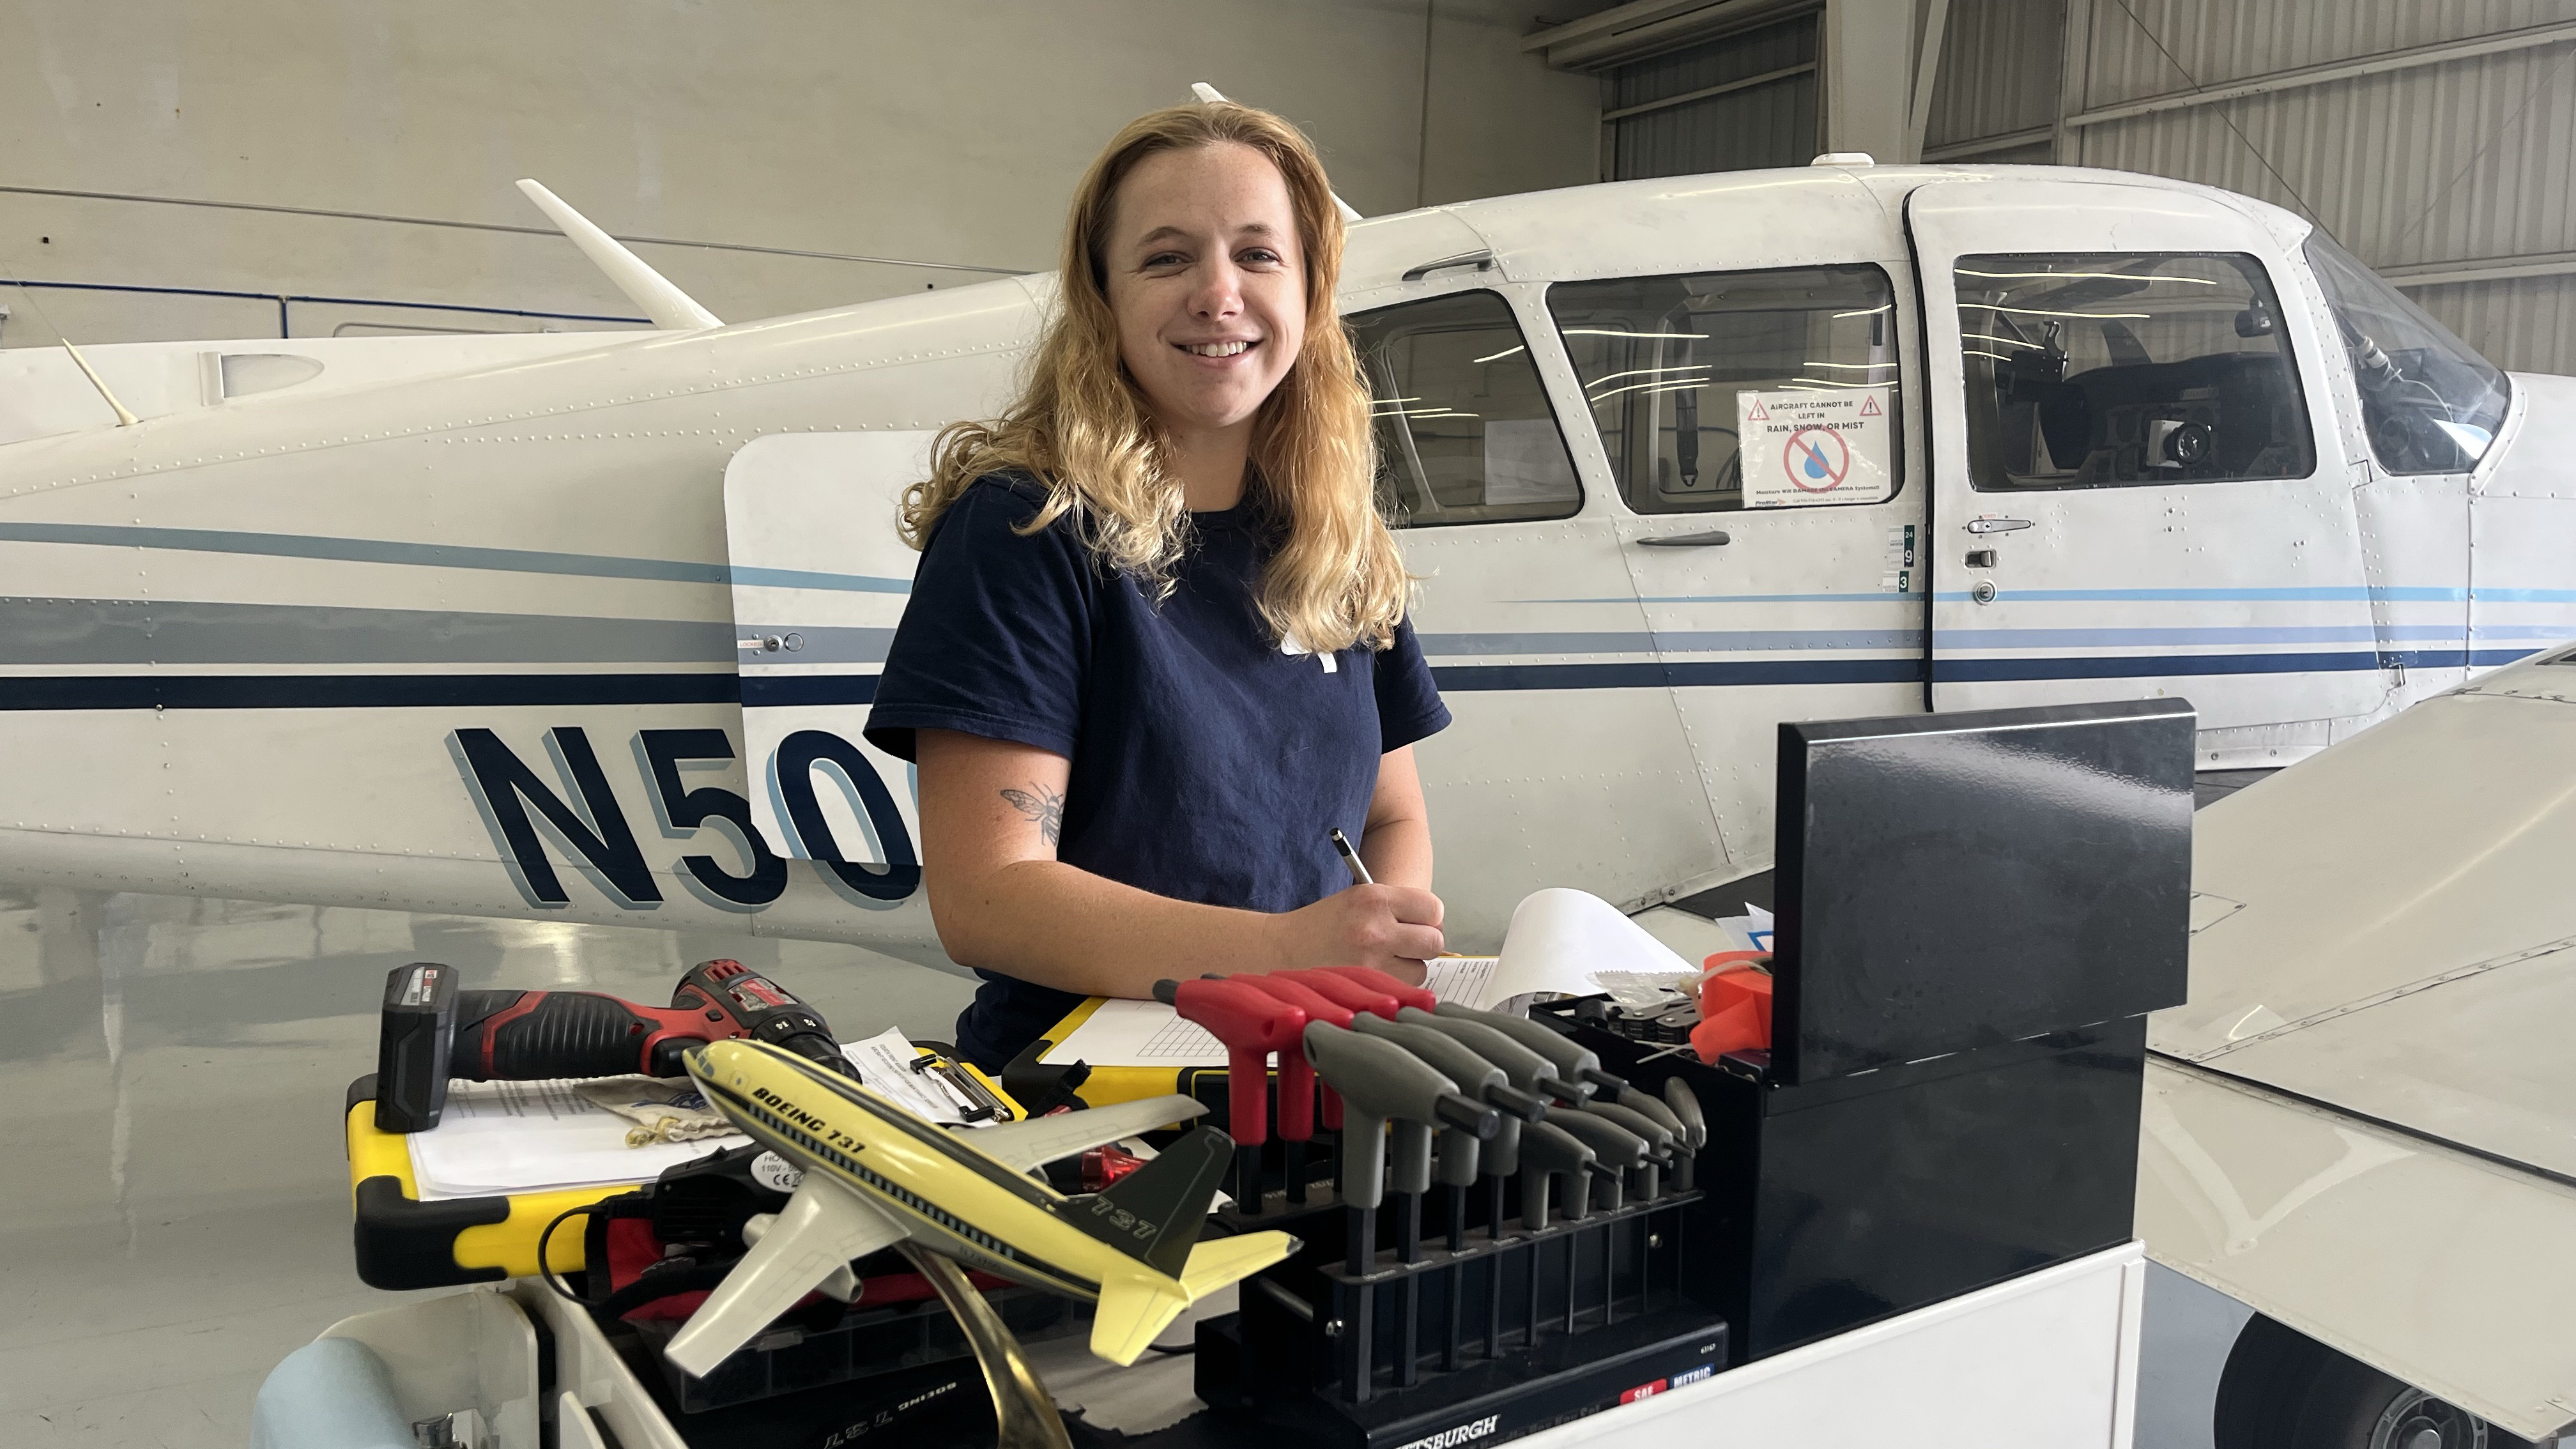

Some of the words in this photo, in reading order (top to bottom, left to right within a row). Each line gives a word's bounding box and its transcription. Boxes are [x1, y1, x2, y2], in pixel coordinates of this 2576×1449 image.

[1767, 425, 1792, 433] RAIN,
[1905, 549, 1913, 563] 9
[1899, 576, 1907, 588] 3
[445, 726, 924, 912] N50
[753, 1087, 825, 1131] BOEING
[827, 1123, 866, 1153] 737
[1091, 1195, 1157, 1239] 737
[898, 1381, 957, 1412] BOEING
[1634, 1384, 1653, 1402] SAE
[1673, 1366, 1711, 1389] METRIC
